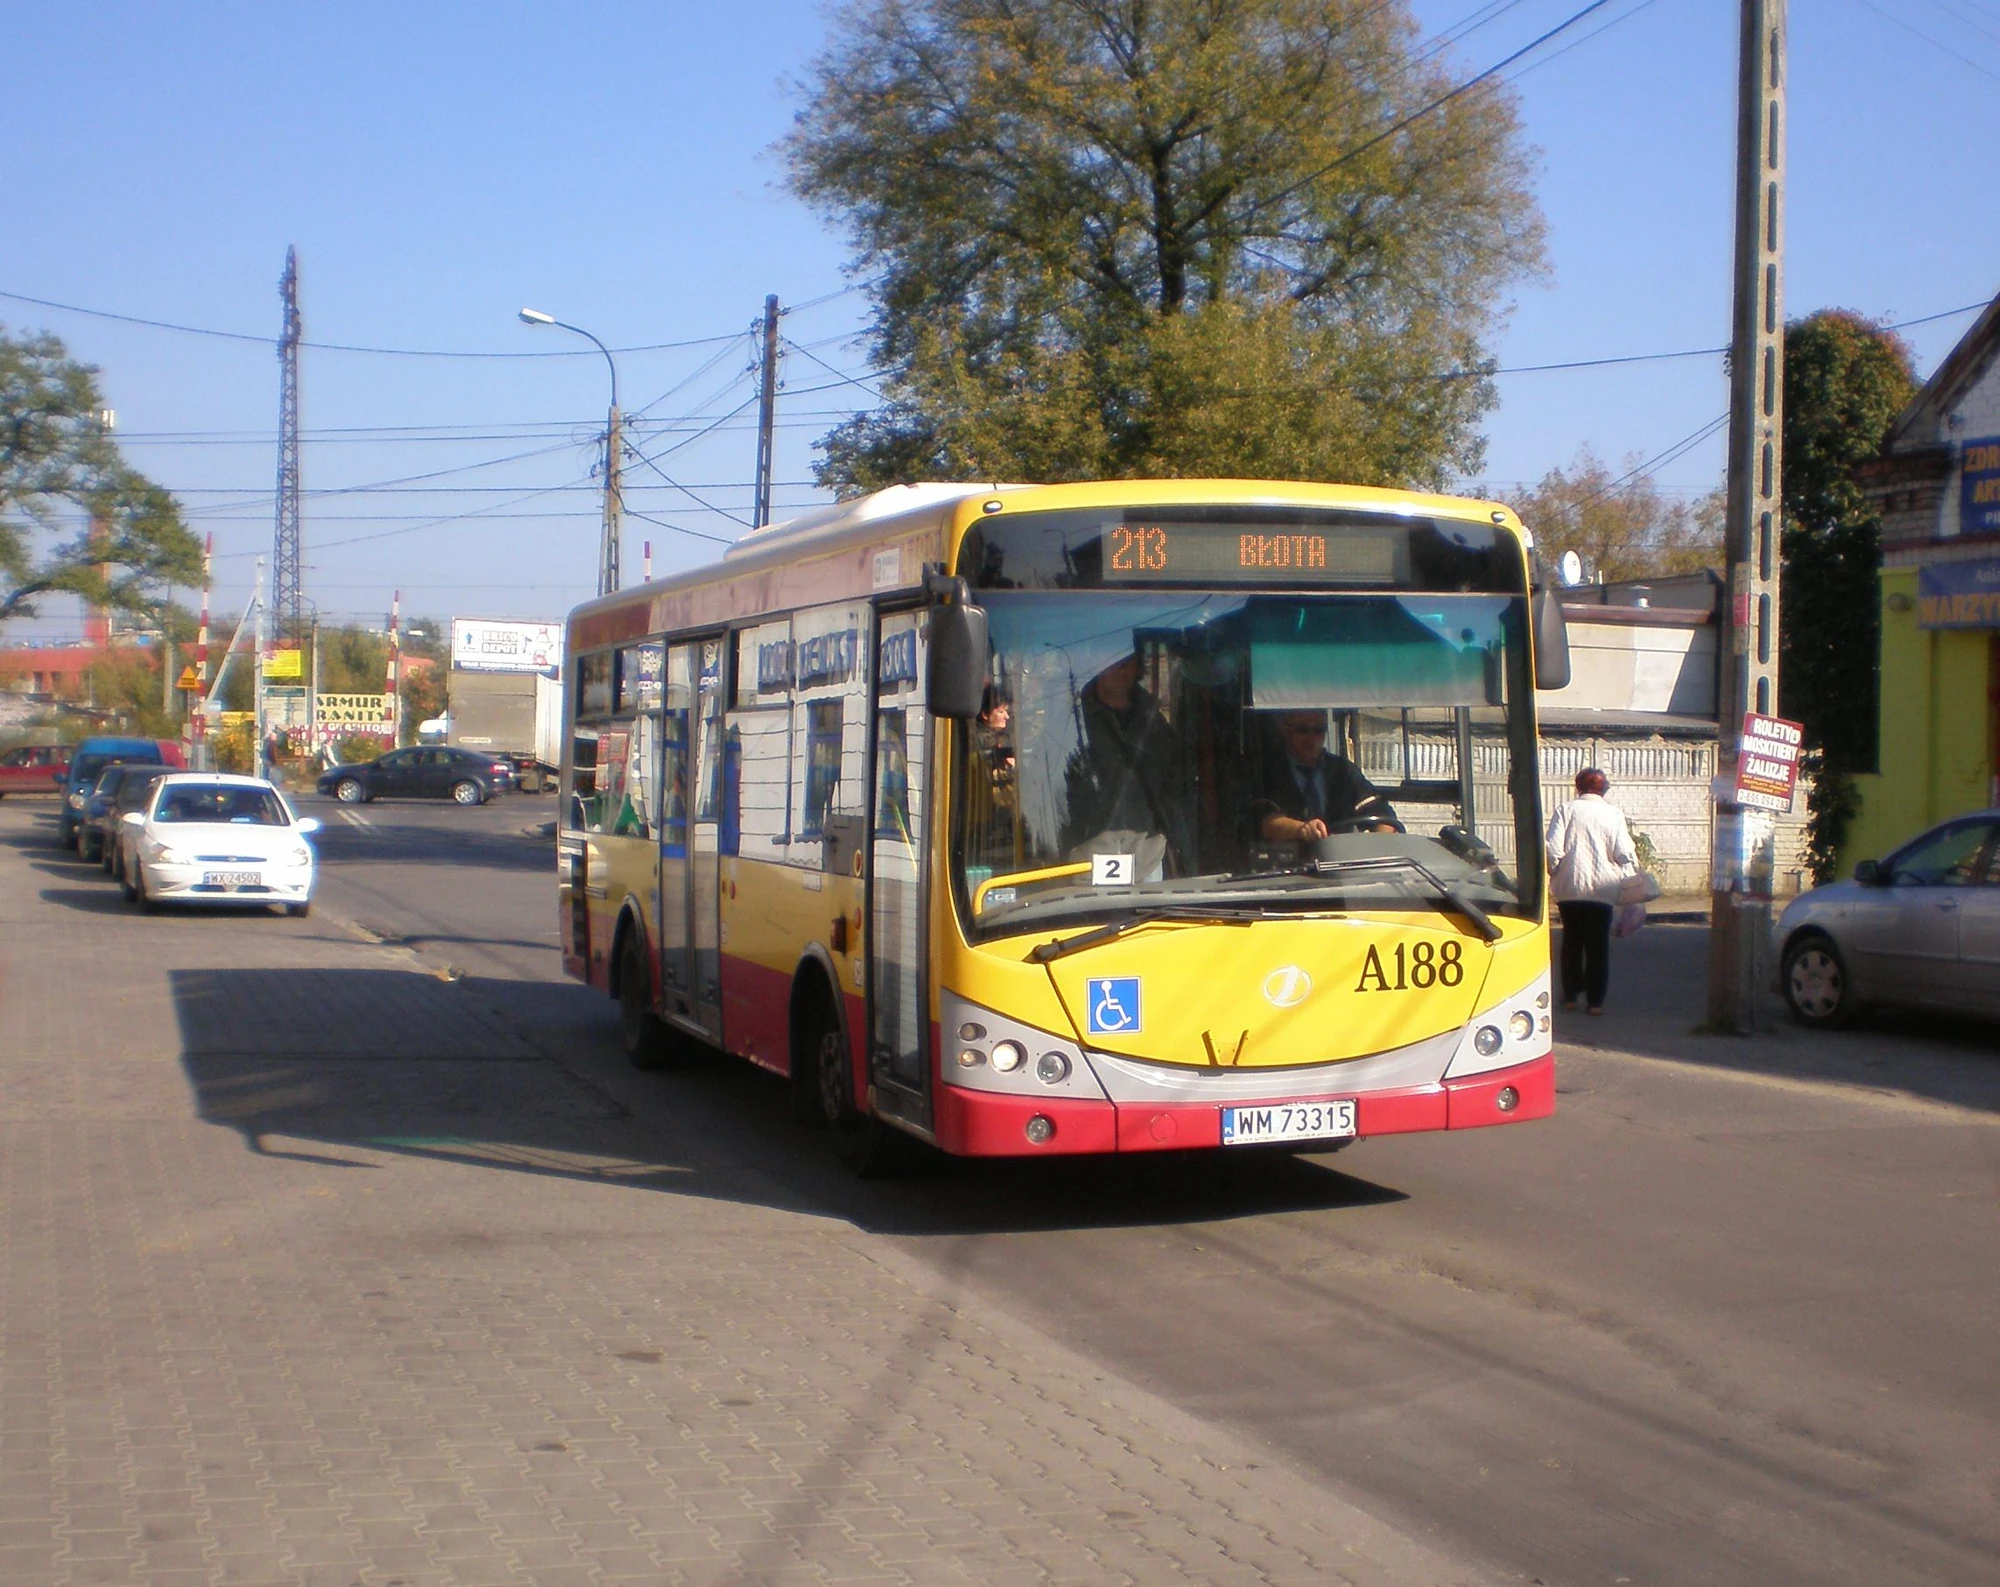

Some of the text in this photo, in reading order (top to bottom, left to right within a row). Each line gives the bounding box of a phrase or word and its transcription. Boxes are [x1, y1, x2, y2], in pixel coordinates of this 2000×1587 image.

[1111, 526, 1167, 570] 213
[1239, 533, 1326, 567] BŁOTA
[1919, 592, 2000, 624] WARZY
[1753, 718, 1793, 741] ROLETY
[1746, 754, 1791, 782] ŻALUZJE
[1104, 859, 1121, 879] 2
[1353, 940, 1464, 993] A188
[1238, 1105, 1351, 1135] WM 73315
